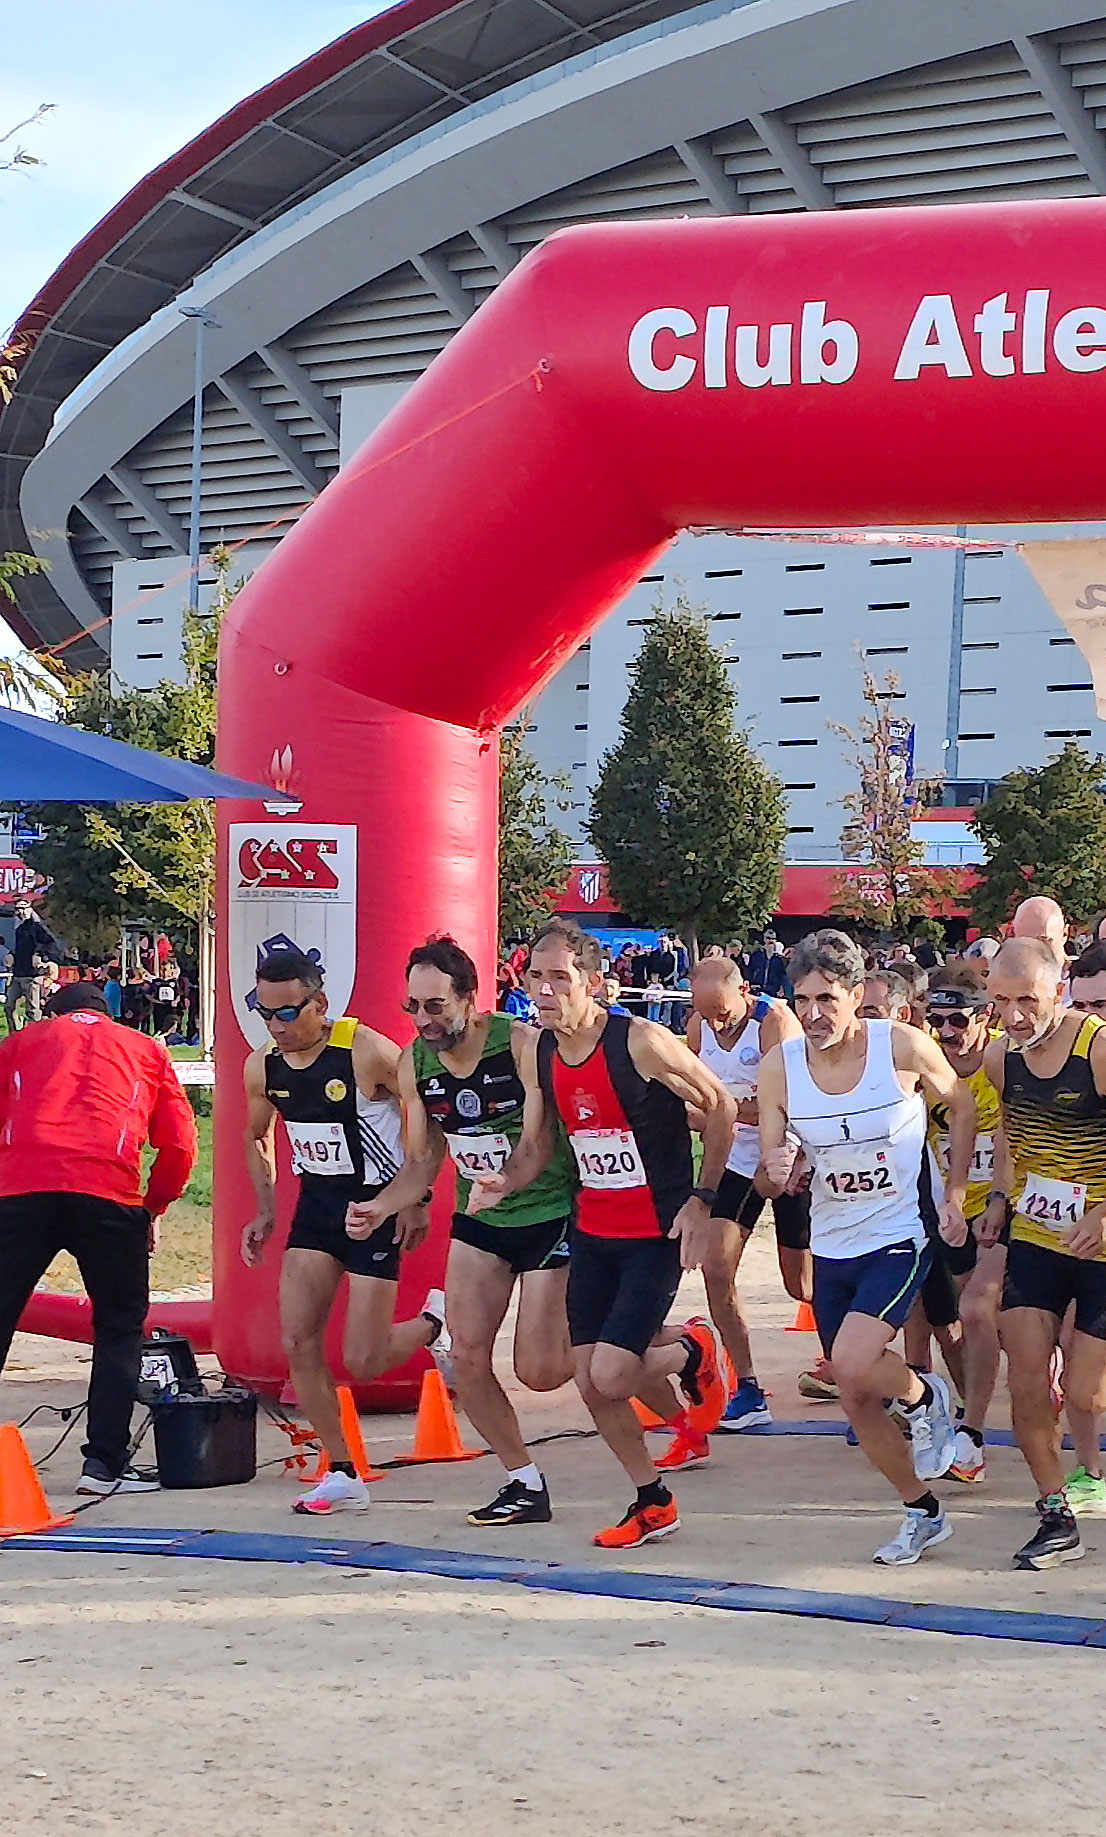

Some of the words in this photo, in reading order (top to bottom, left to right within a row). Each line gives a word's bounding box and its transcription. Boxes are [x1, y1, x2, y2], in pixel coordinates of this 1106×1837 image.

[628, 300, 859, 392] Club
[293, 1138, 342, 1162] 1197
[456, 1150, 507, 1171] 1217
[580, 1151, 635, 1175] 1320
[825, 1167, 893, 1193] 1252
